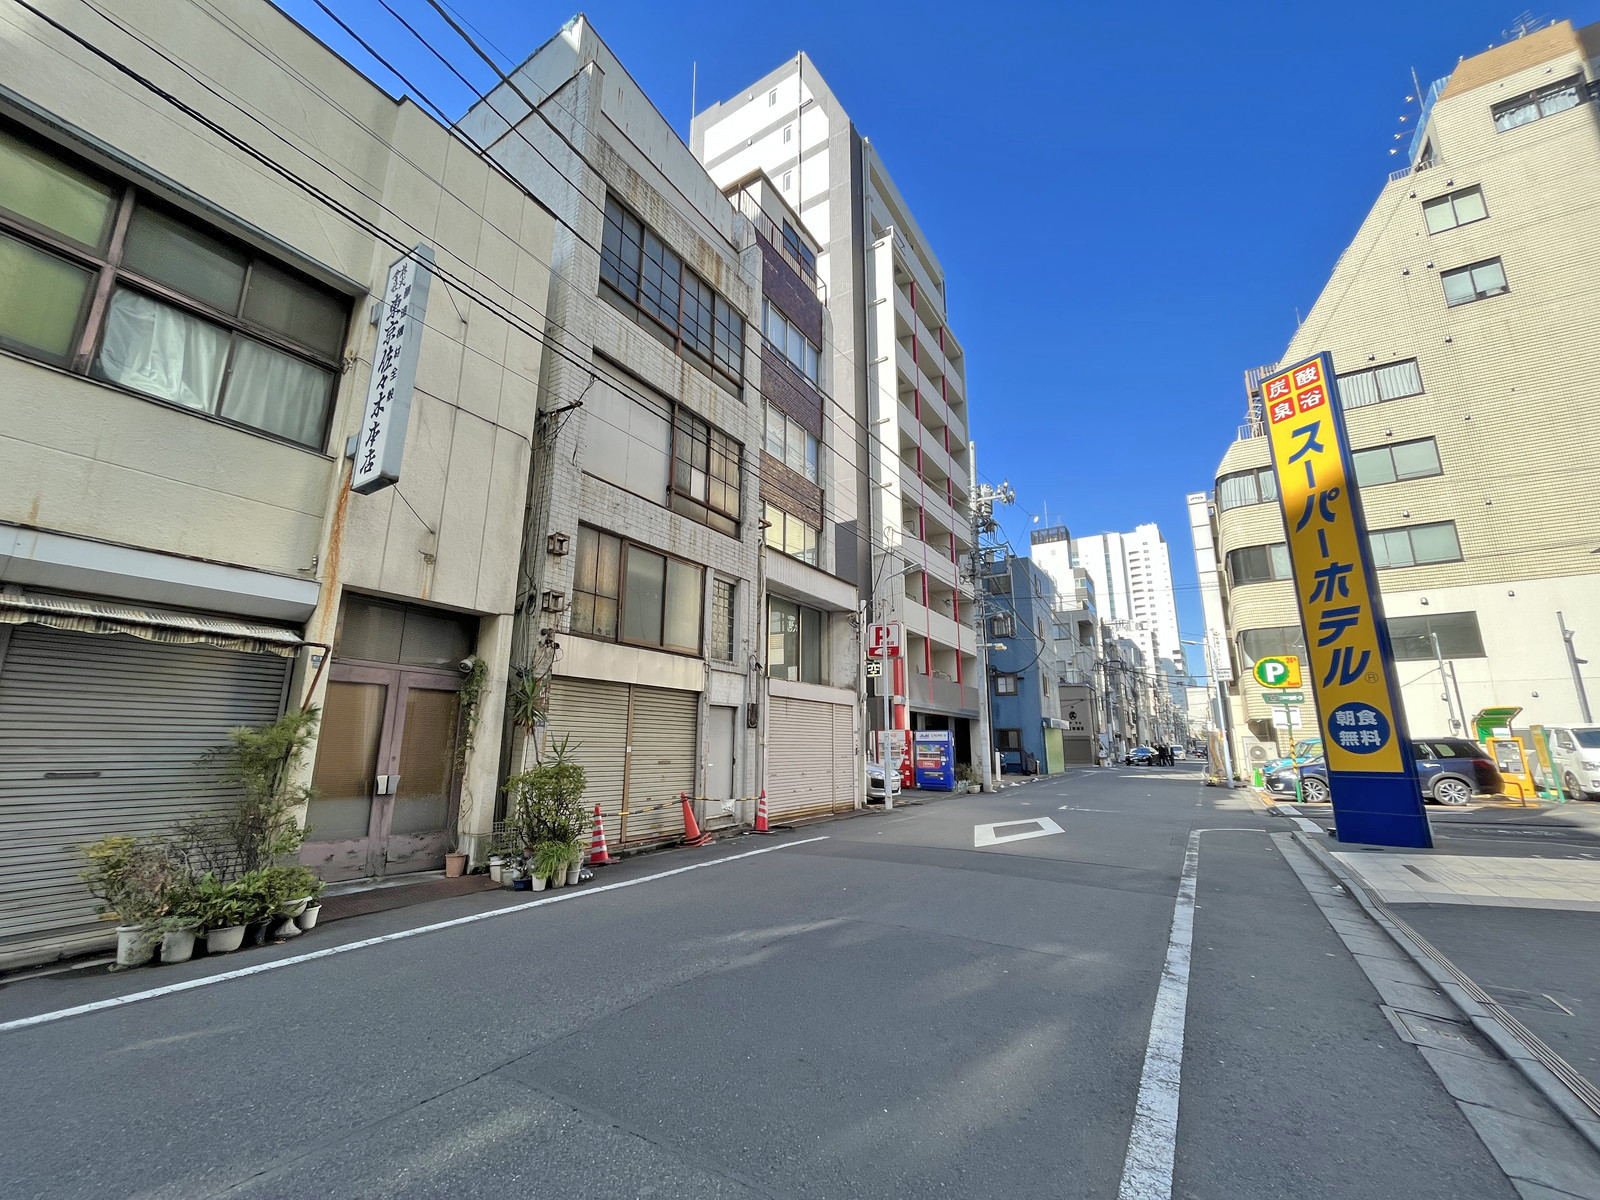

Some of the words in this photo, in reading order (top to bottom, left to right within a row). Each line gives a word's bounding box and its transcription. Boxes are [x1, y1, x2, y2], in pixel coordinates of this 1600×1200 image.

[1269, 367, 1320, 398] 炭酸
[1274, 389, 1323, 421] 泉浴
[1288, 420, 1371, 688] スーパーホテル
[875, 627, 891, 646] P
[867, 662, 880, 677] 空
[1265, 662, 1285, 683] P
[1335, 709, 1378, 726] 朝食
[1339, 729, 1382, 746] 無料
